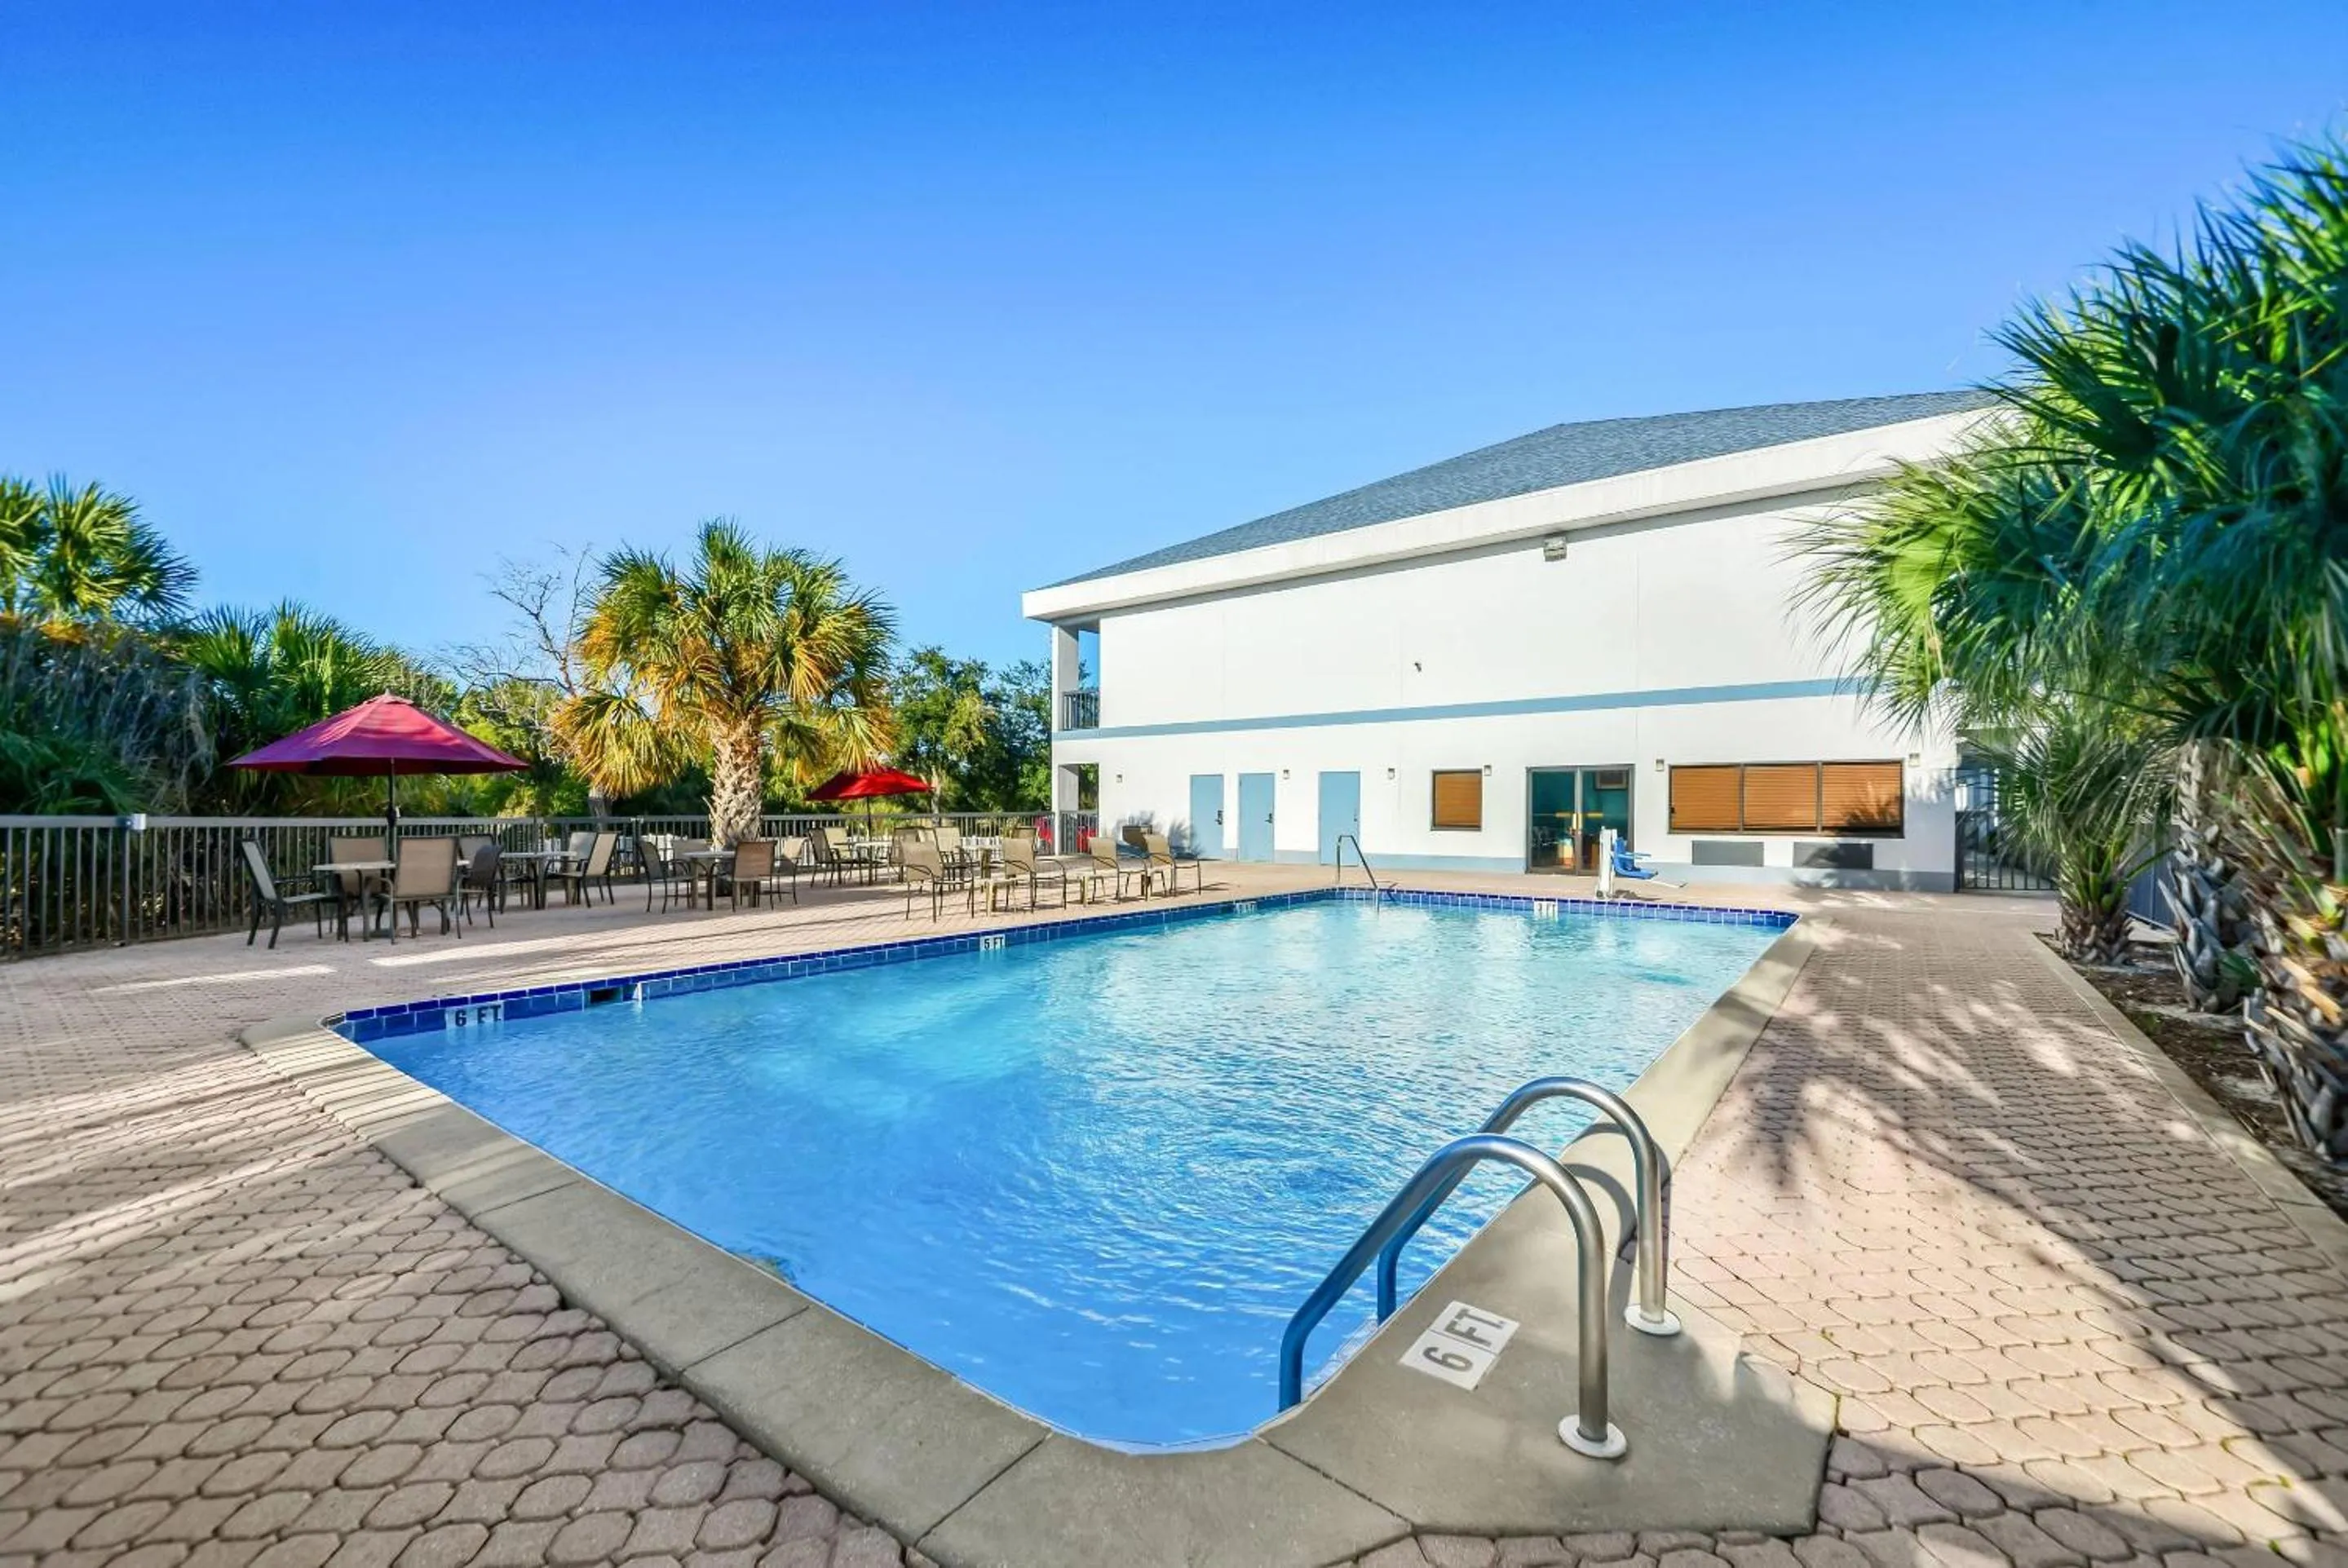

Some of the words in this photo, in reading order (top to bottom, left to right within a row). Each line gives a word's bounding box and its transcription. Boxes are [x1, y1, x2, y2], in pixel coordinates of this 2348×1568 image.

[984, 938, 990, 949] 5
[455, 1009, 467, 1027] 6
[1422, 1346, 1474, 1372] 6
